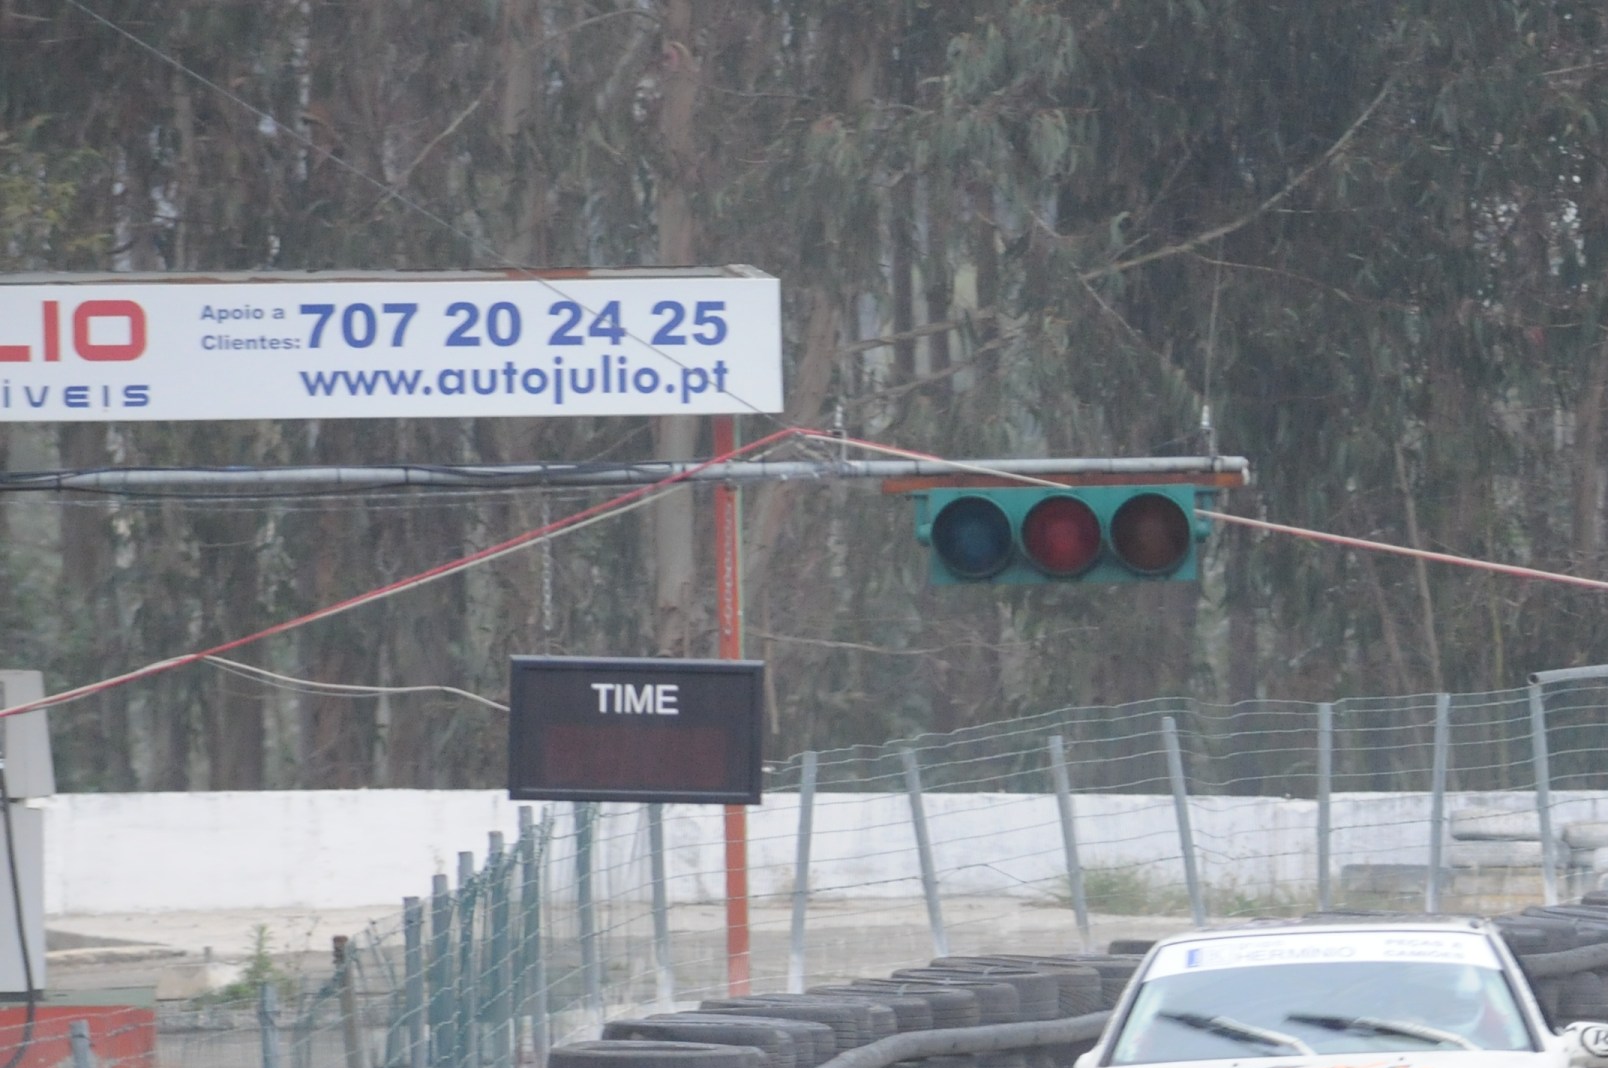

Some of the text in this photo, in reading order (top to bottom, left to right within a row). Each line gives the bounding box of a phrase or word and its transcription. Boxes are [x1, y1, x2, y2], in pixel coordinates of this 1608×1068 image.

[201, 304, 285, 324] Apoio a
[300, 300, 728, 349] 707 20 24 25
[201, 334, 301, 350] Clientes:
[300, 354, 728, 404] www.autojulio.pt
[590, 683, 680, 715] TIME
